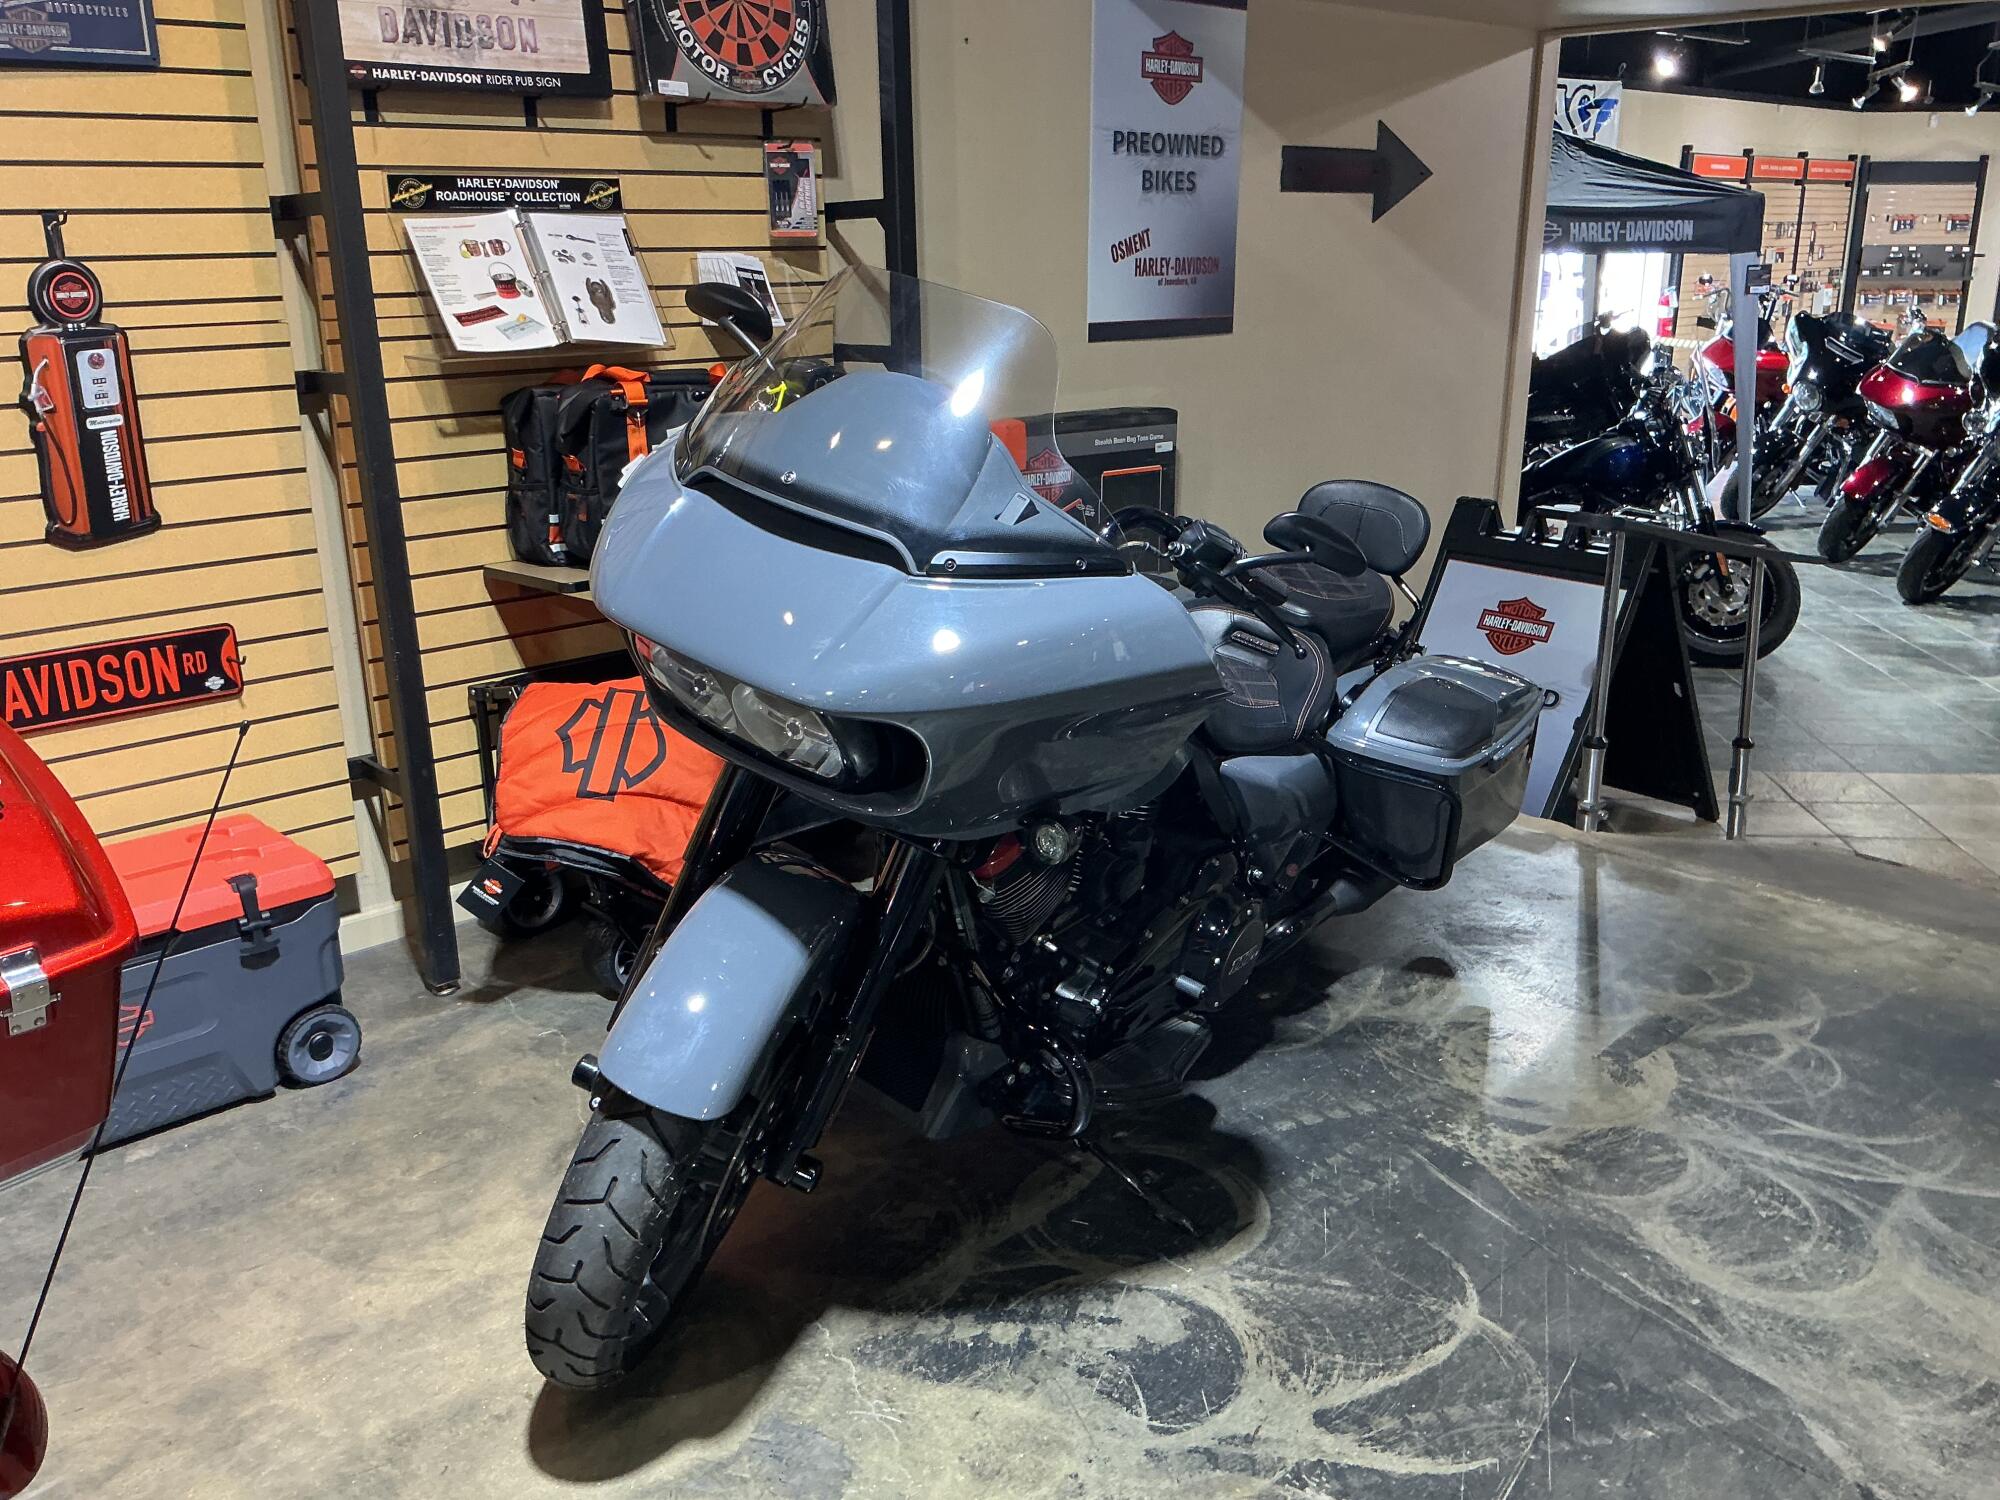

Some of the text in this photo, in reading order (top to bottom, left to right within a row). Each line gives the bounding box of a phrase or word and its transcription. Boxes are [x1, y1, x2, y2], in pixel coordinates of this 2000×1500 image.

[44, 1, 129, 18] MOTORCYCLES
[378, 5, 540, 54] DAVIDSON
[668, 8, 729, 84] MOTOR
[762, 18, 809, 87] CYCLES
[372, 67, 483, 85] HARLEY-DAVIDSON
[486, 74, 513, 86] RIDER
[515, 76, 534, 87] PUB
[536, 77, 561, 88] SIGN
[1145, 57, 1199, 77] HARLEY-DAVIDSON
[1112, 130, 1225, 157] PREOWNED
[1141, 169, 1197, 192] BIKES
[514, 192, 581, 203] COLLECTION
[1570, 219, 1694, 243] HARLEY-DAVIDSON
[1110, 227, 1151, 264] OSMENT
[1134, 256, 1220, 277] HARLEY-DAVIDSON
[100, 429, 131, 522] HARLEY-DAVIDSON
[1504, 603, 1538, 619] MOTOR
[1483, 615, 1547, 637] HARLEY-DAVIDSON
[1493, 633, 1528, 650] CYCLES
[182, 650, 208, 676] RD
